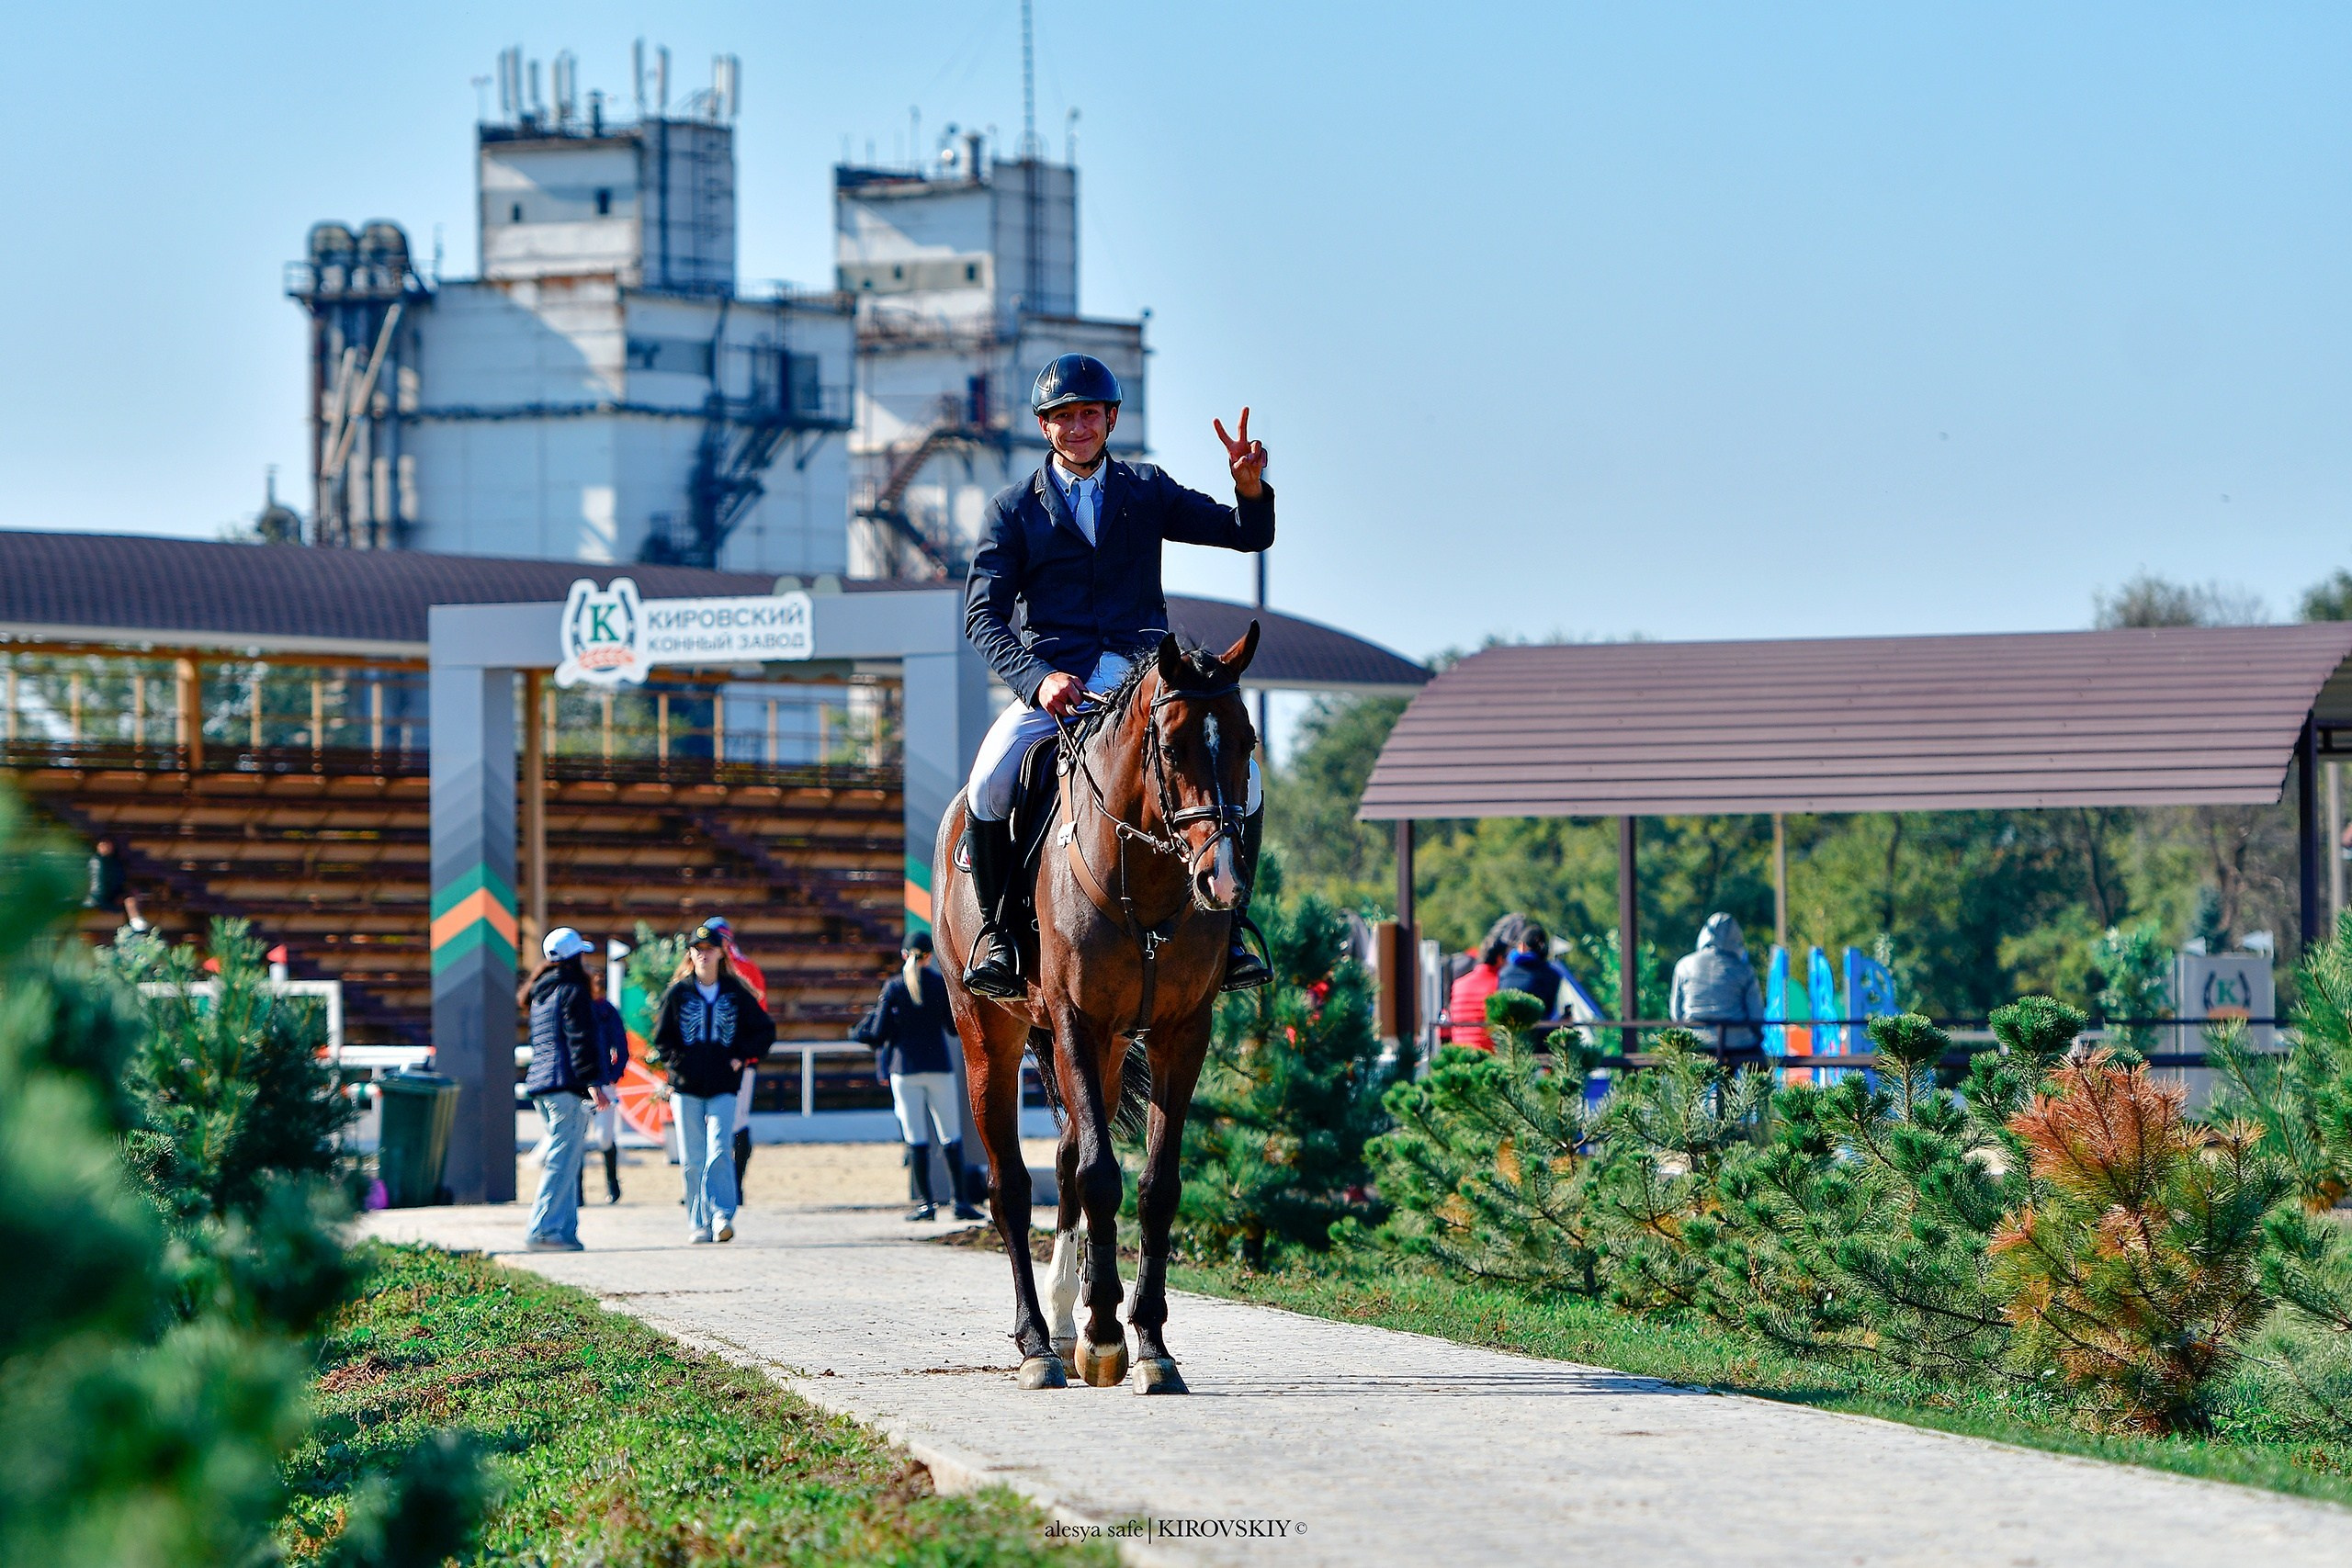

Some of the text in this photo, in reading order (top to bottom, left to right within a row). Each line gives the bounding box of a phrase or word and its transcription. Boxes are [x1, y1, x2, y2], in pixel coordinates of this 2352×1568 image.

[648, 603, 805, 630] КИРОВСКИЙ
[648, 632, 805, 653] КОННЫЙ ЗАВОД
